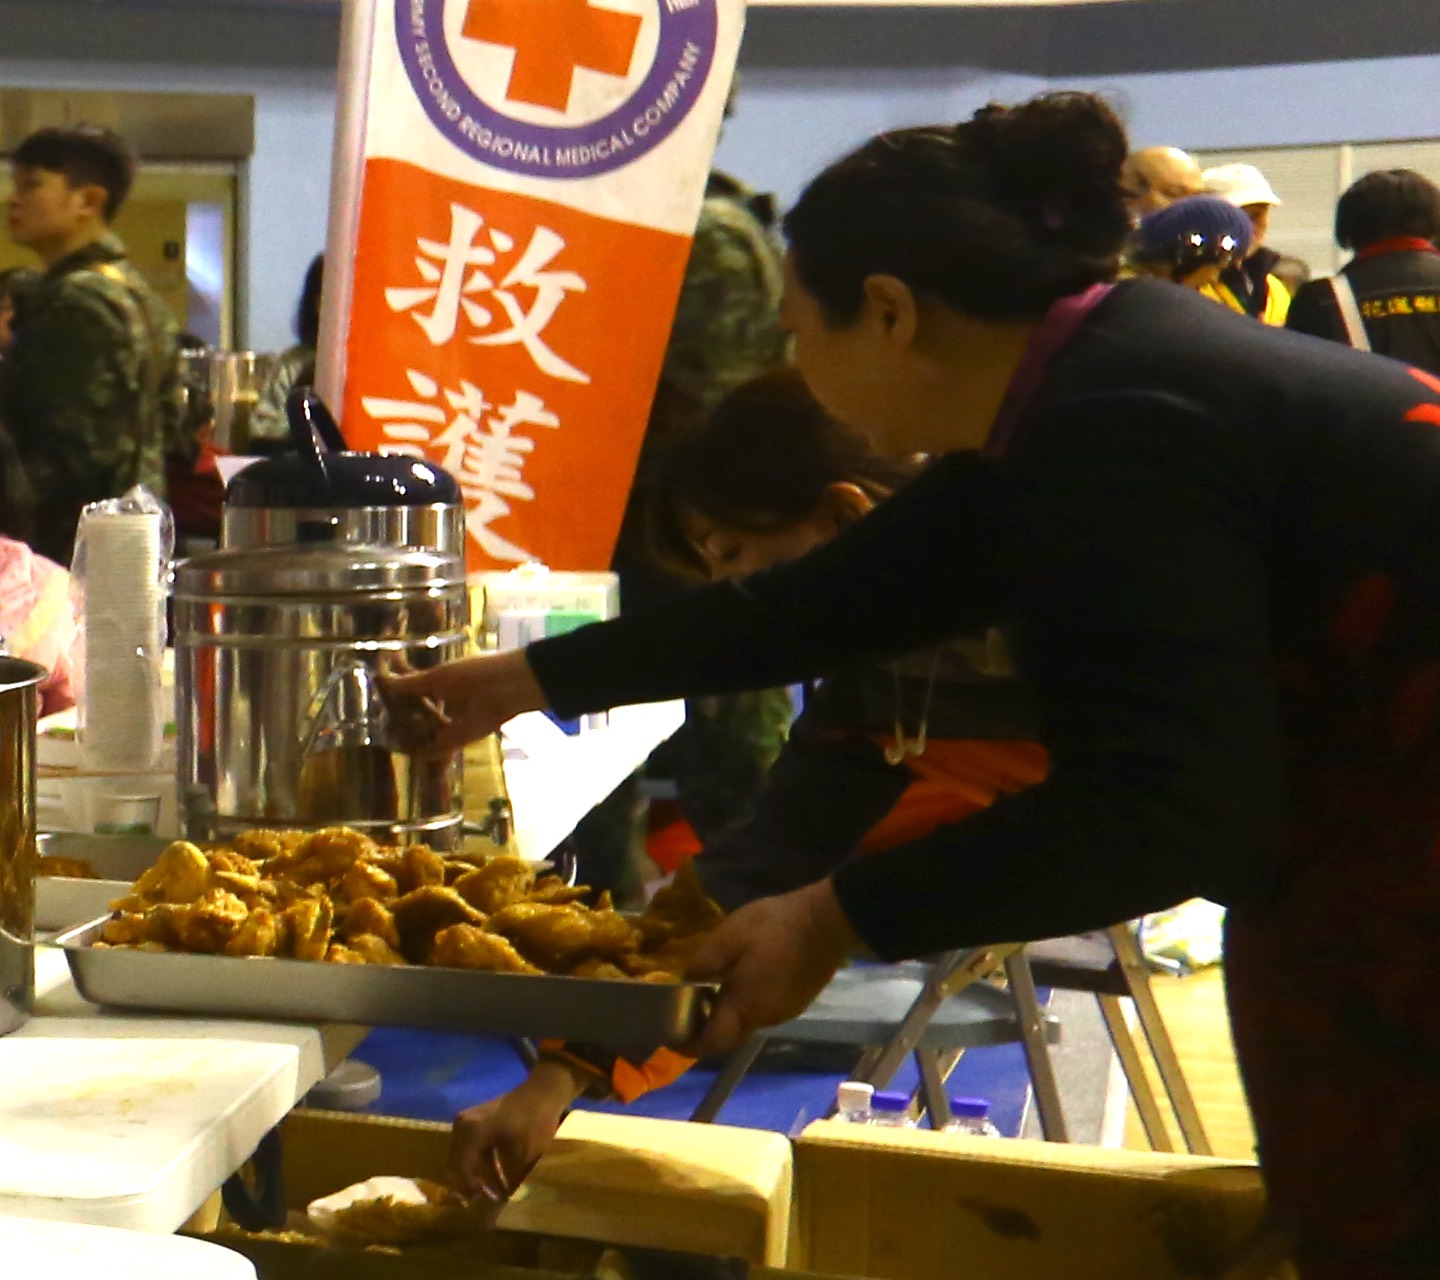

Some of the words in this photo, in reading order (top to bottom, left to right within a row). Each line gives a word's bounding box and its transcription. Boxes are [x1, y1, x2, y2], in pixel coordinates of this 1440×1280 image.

[415, 42, 460, 121] SECOND
[460, 116, 551, 166] REGIONAL
[556, 135, 633, 168] MEDICAL
[632, 40, 702, 136] COMPANY
